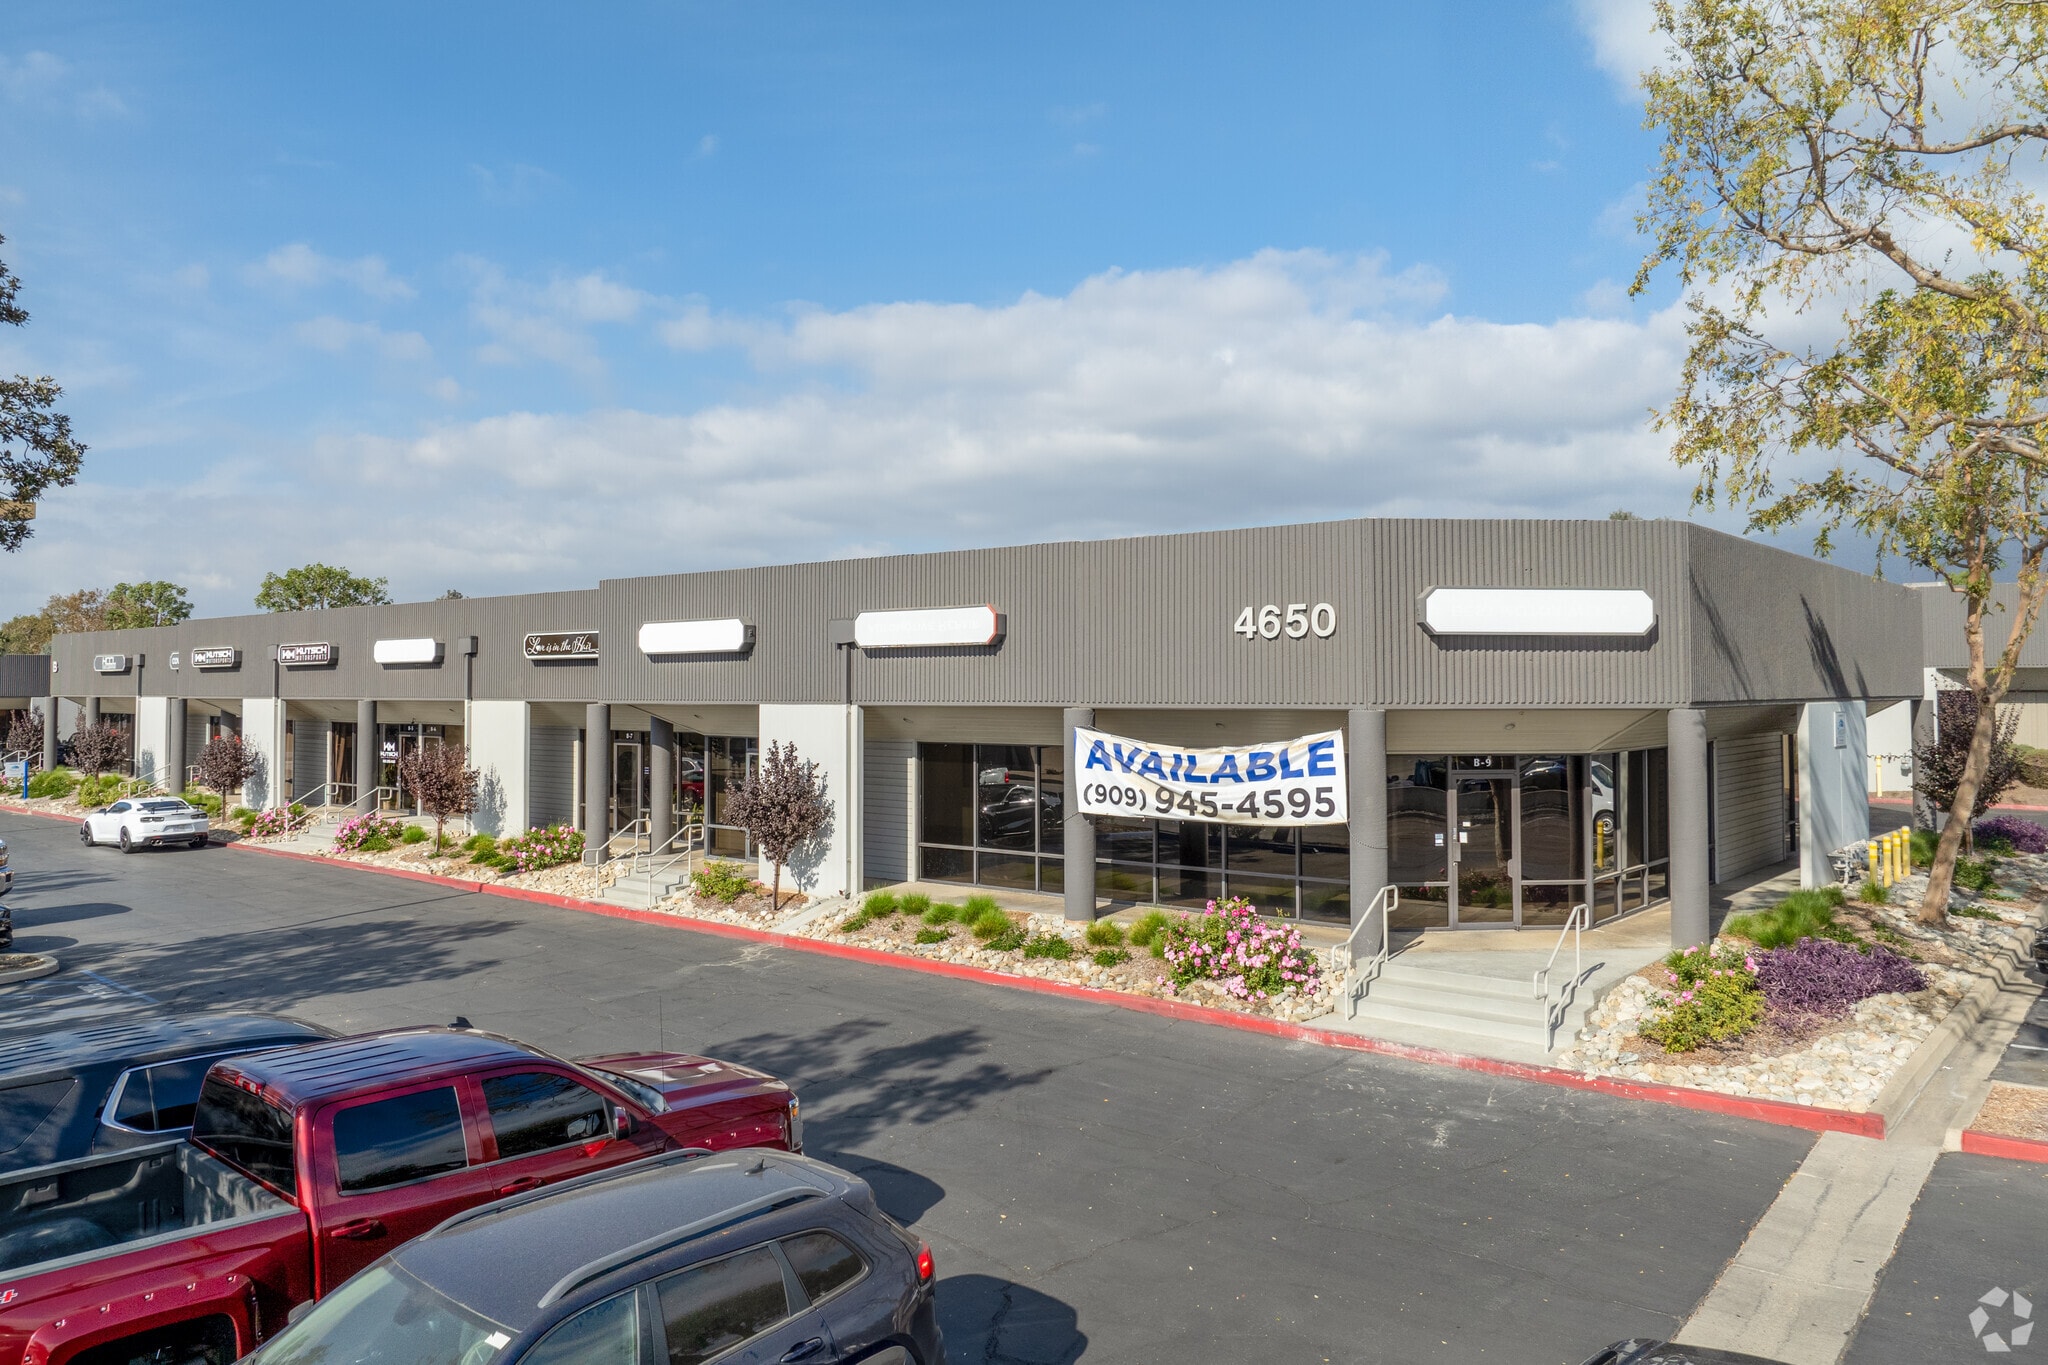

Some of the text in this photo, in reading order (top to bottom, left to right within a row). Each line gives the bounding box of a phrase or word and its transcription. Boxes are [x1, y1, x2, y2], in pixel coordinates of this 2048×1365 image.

[1233, 602, 1337, 639] 4650
[296, 645, 327, 655] KUTSCH
[560, 639, 572, 652] the
[206, 650, 232, 659] KUTSCH
[1085, 739, 1337, 784] AVAILABLE
[1473, 758, 1492, 767] B-9
[1083, 783, 1336, 819] (909) 945-4595
